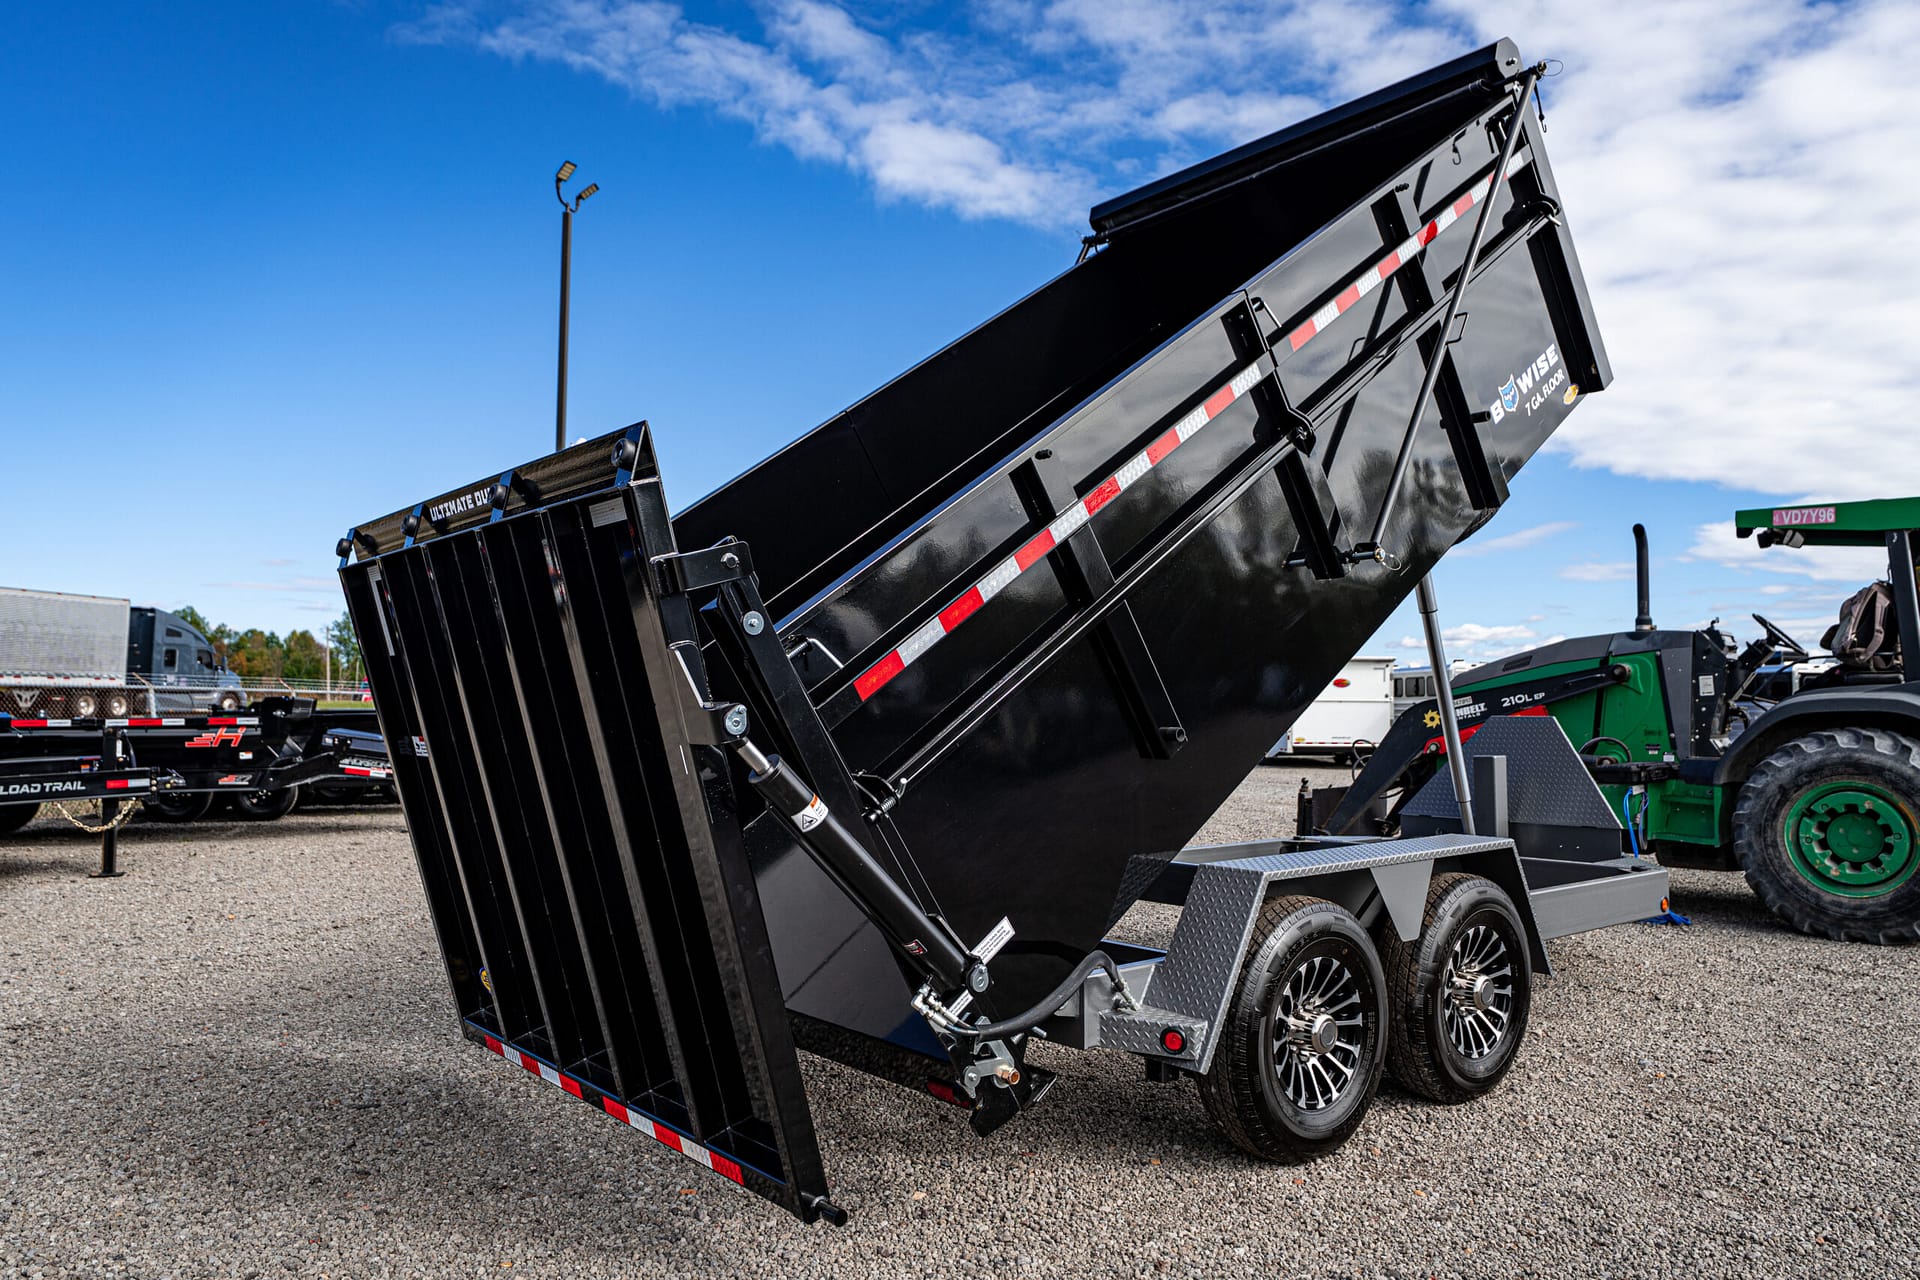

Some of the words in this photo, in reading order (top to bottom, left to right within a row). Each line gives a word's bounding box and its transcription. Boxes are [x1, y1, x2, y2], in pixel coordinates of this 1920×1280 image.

[1542, 368, 1565, 398] FLOOR
[429, 494, 475, 522] ULTIMATE
[473, 487, 490, 507] DU
[1782, 508, 1834, 525] VD7Y96
[1501, 694, 1533, 707] 210L
[0, 784, 41, 795] LOAD
[43, 780, 86, 793] TRAIL
